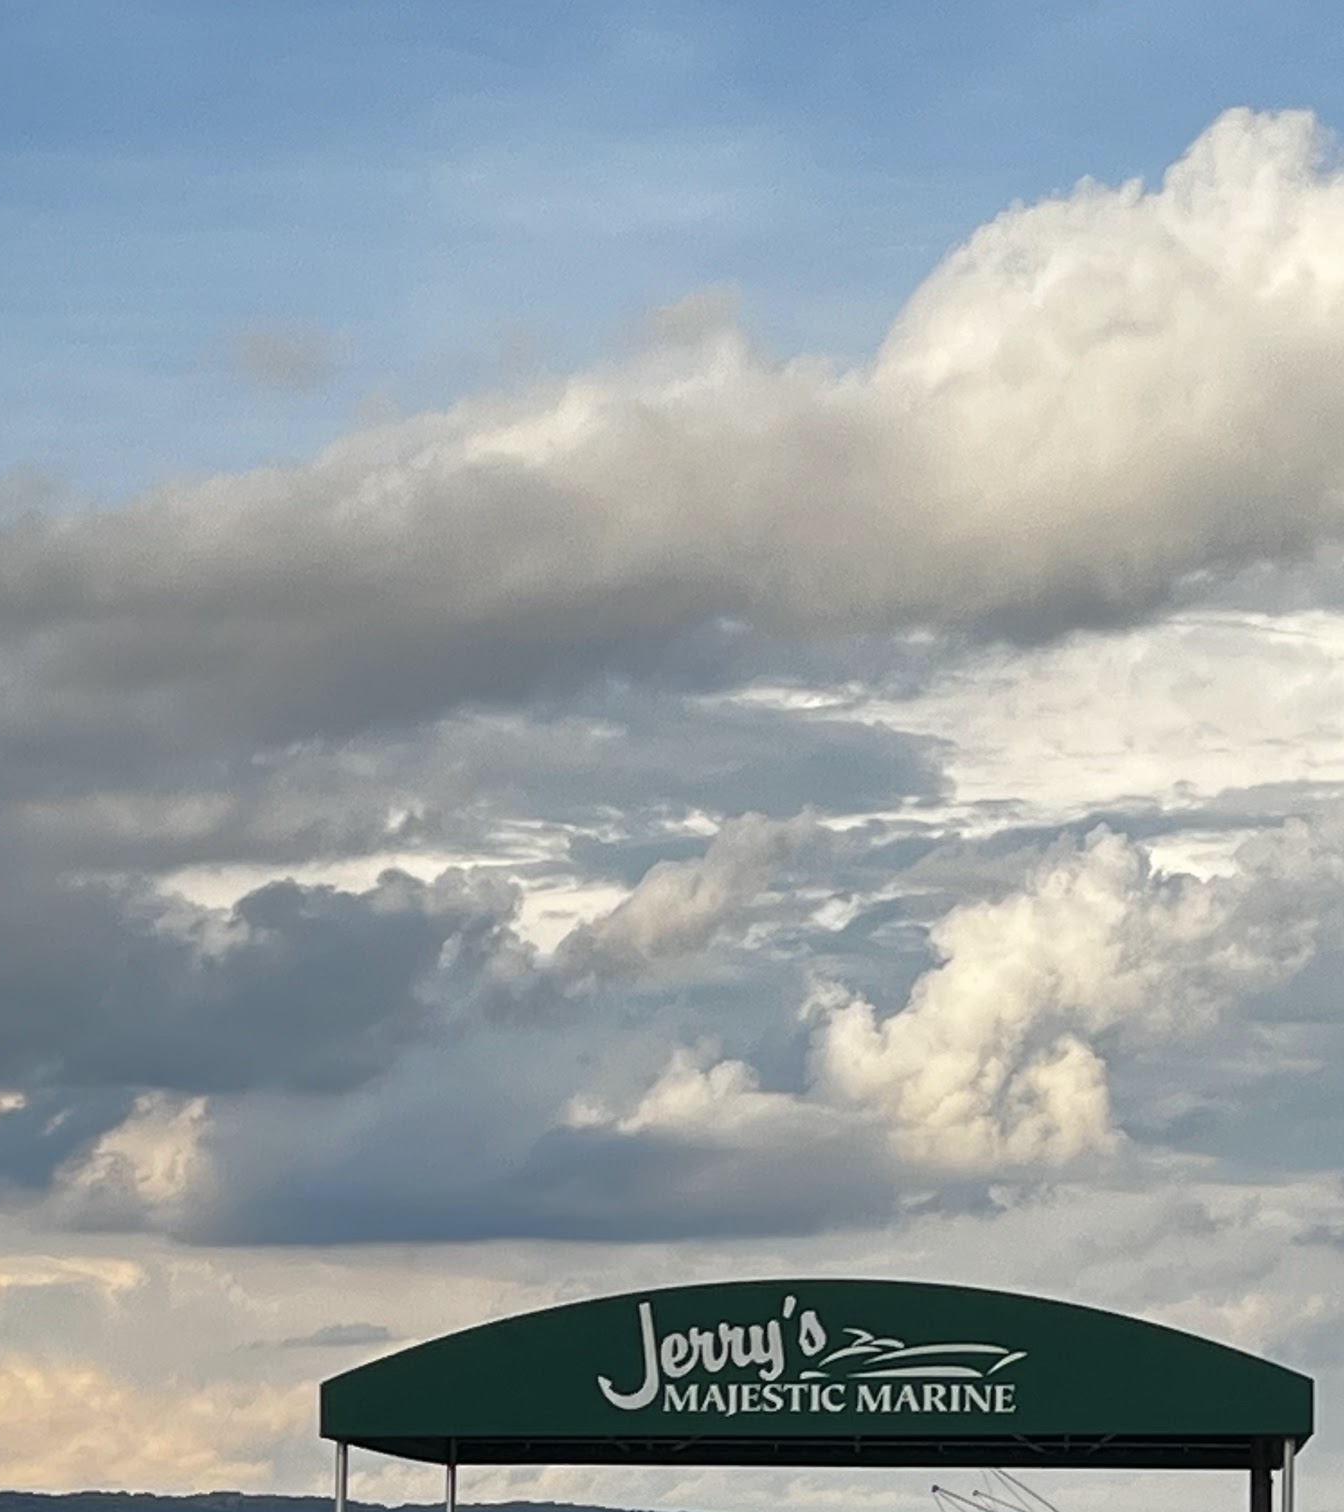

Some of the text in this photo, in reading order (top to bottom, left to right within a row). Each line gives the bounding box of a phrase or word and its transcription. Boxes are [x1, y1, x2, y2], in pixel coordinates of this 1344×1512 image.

[597, 1295, 827, 1411] Jerry's
[662, 1383, 1017, 1417] MAJESTIC MARINE
